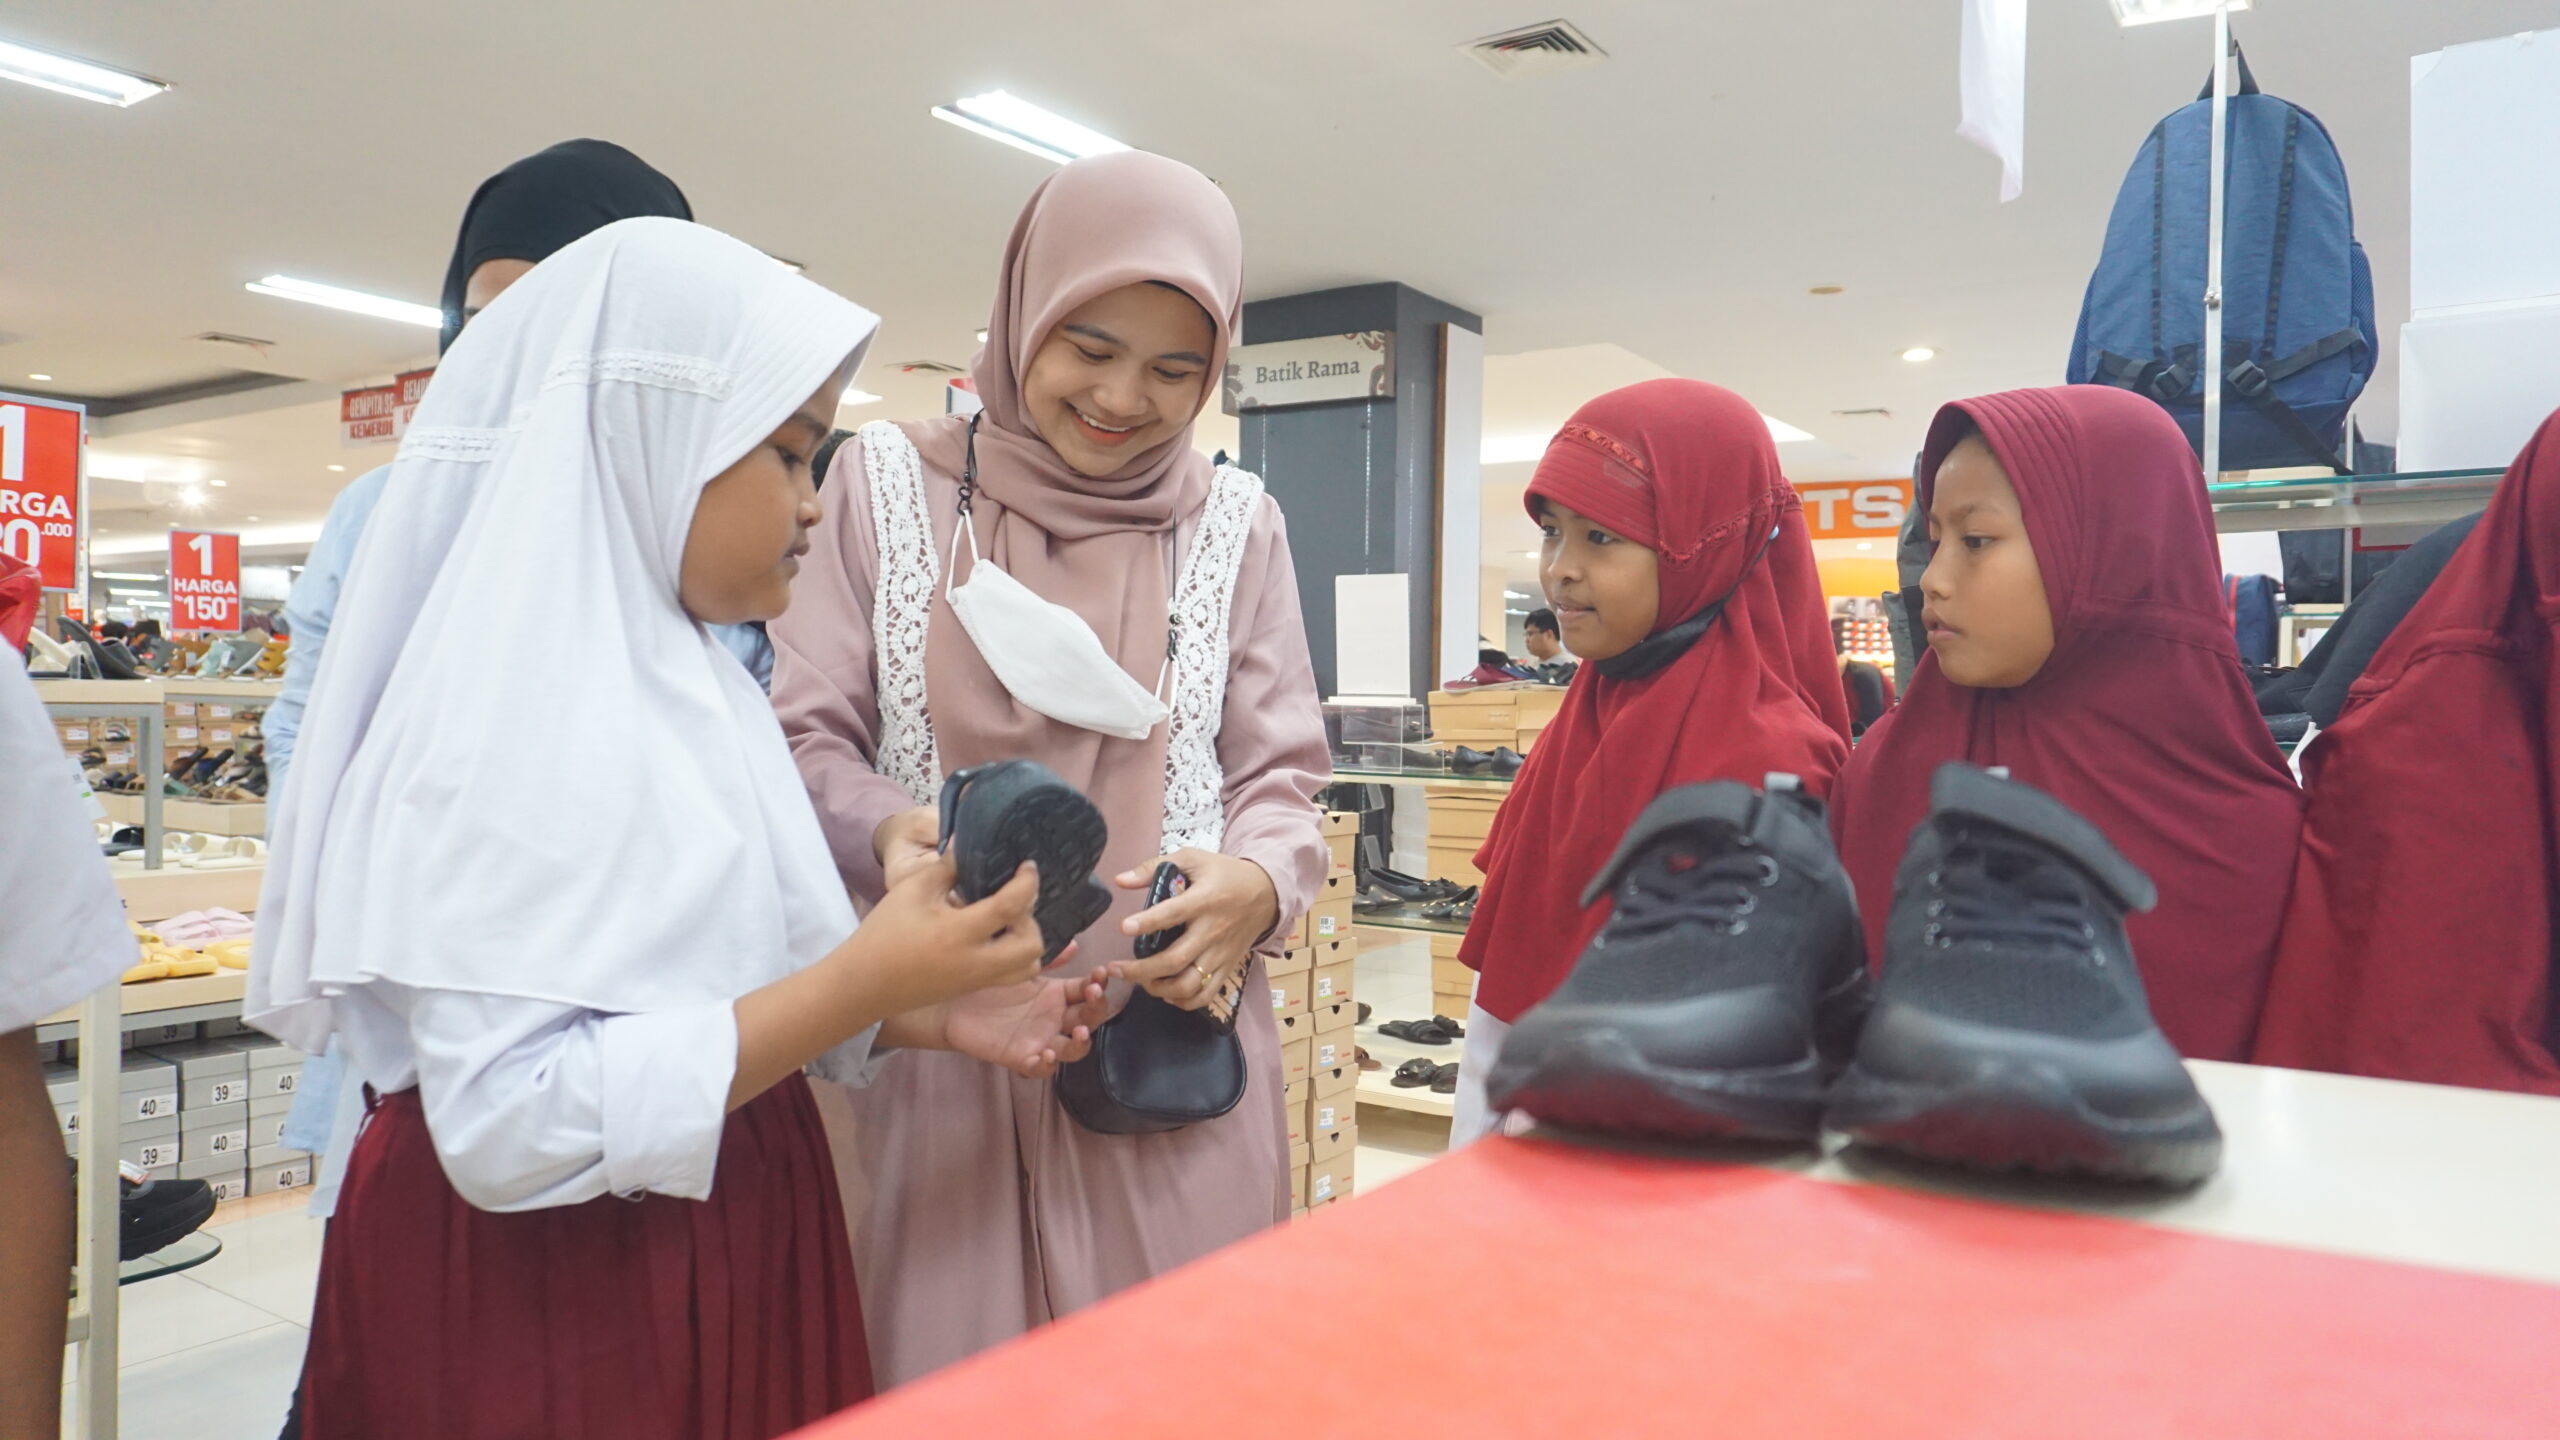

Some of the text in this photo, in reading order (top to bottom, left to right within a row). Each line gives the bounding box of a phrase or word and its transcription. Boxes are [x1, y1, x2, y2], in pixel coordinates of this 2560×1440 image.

[1255, 360, 1360, 384] Batik Rama
[0, 404, 26, 482] 1
[0, 489, 73, 519] RGA
[1802, 485, 1904, 530] TS
[188, 534, 213, 576] 1
[174, 577, 237, 595] HARGA
[163, 1024, 177, 1039] 39
[279, 1075, 293, 1091] 40
[214, 1085, 229, 1101] 39
[140, 1099, 156, 1116] 40
[213, 1135, 227, 1151] 40
[142, 1148, 158, 1166] 39
[279, 1171, 293, 1187] 40
